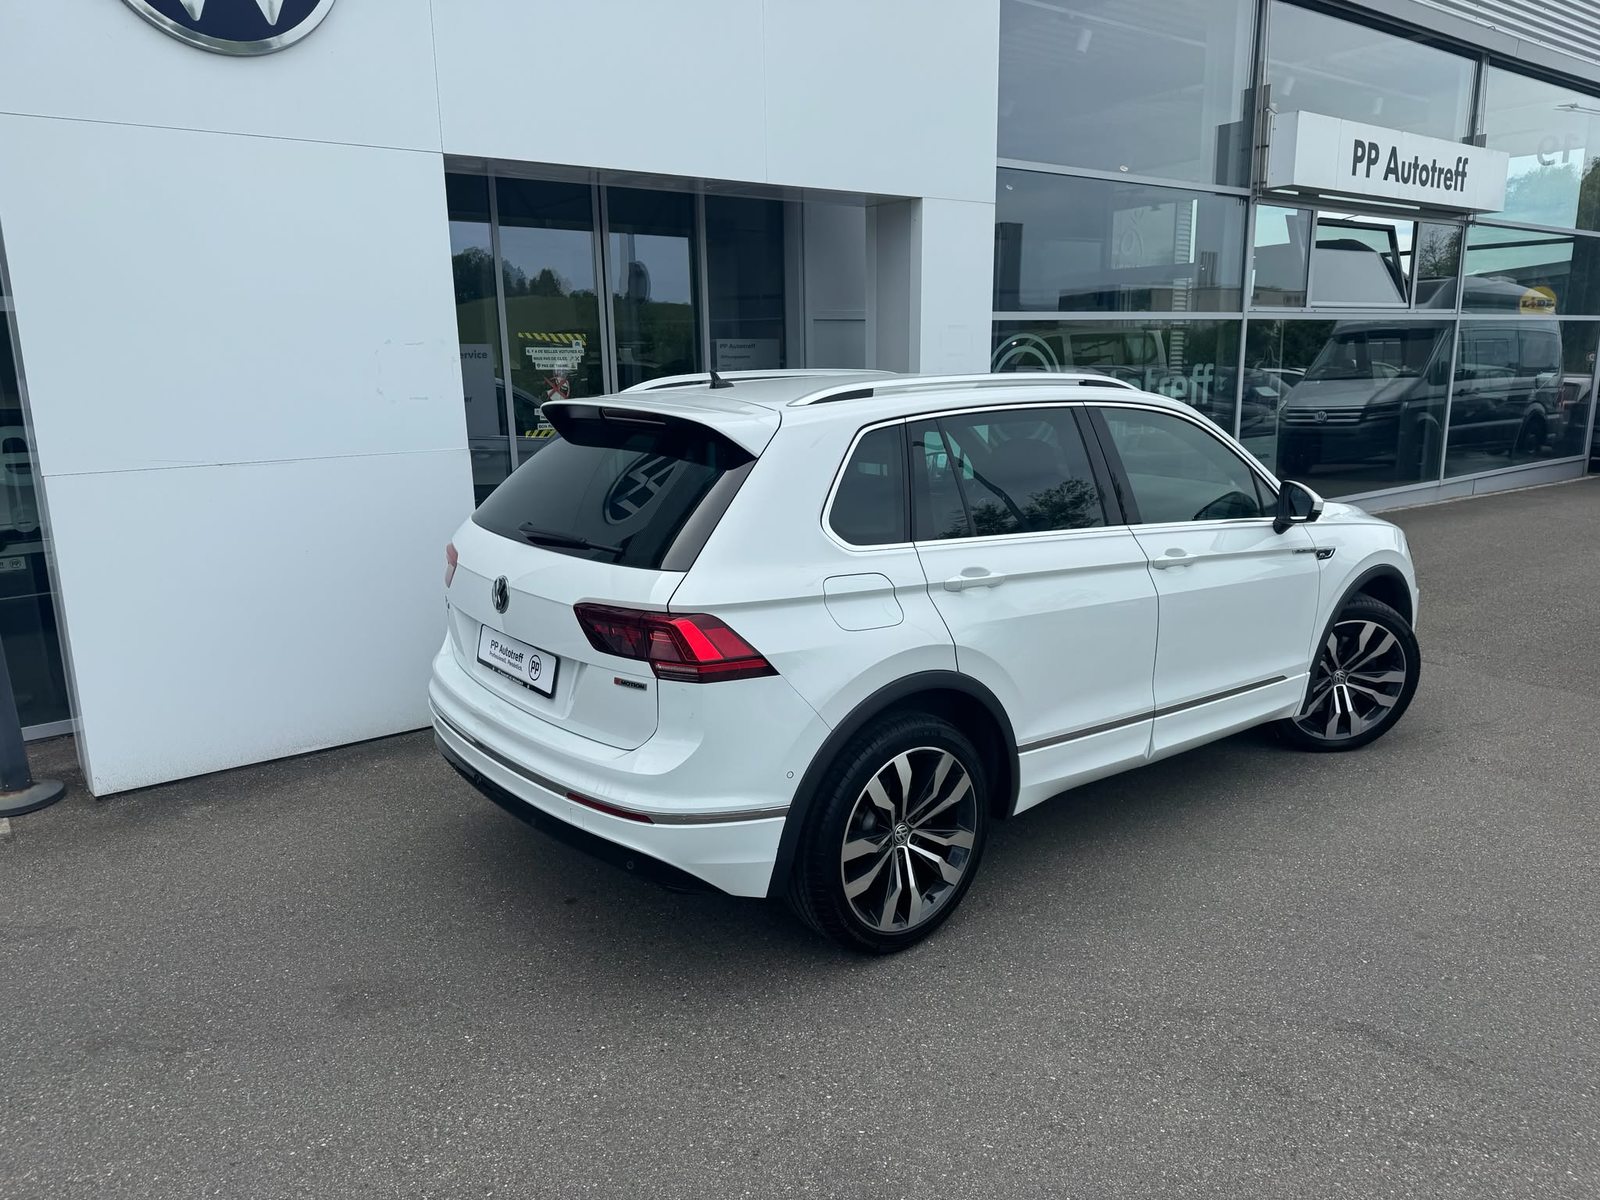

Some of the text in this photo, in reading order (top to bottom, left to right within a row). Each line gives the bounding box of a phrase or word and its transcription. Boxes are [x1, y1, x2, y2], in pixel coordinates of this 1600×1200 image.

[1351, 138, 1469, 192] PP Autotreff
[460, 349, 488, 359] ervice
[490, 639, 525, 664] PP Autotreff
[530, 660, 540, 675] PP
